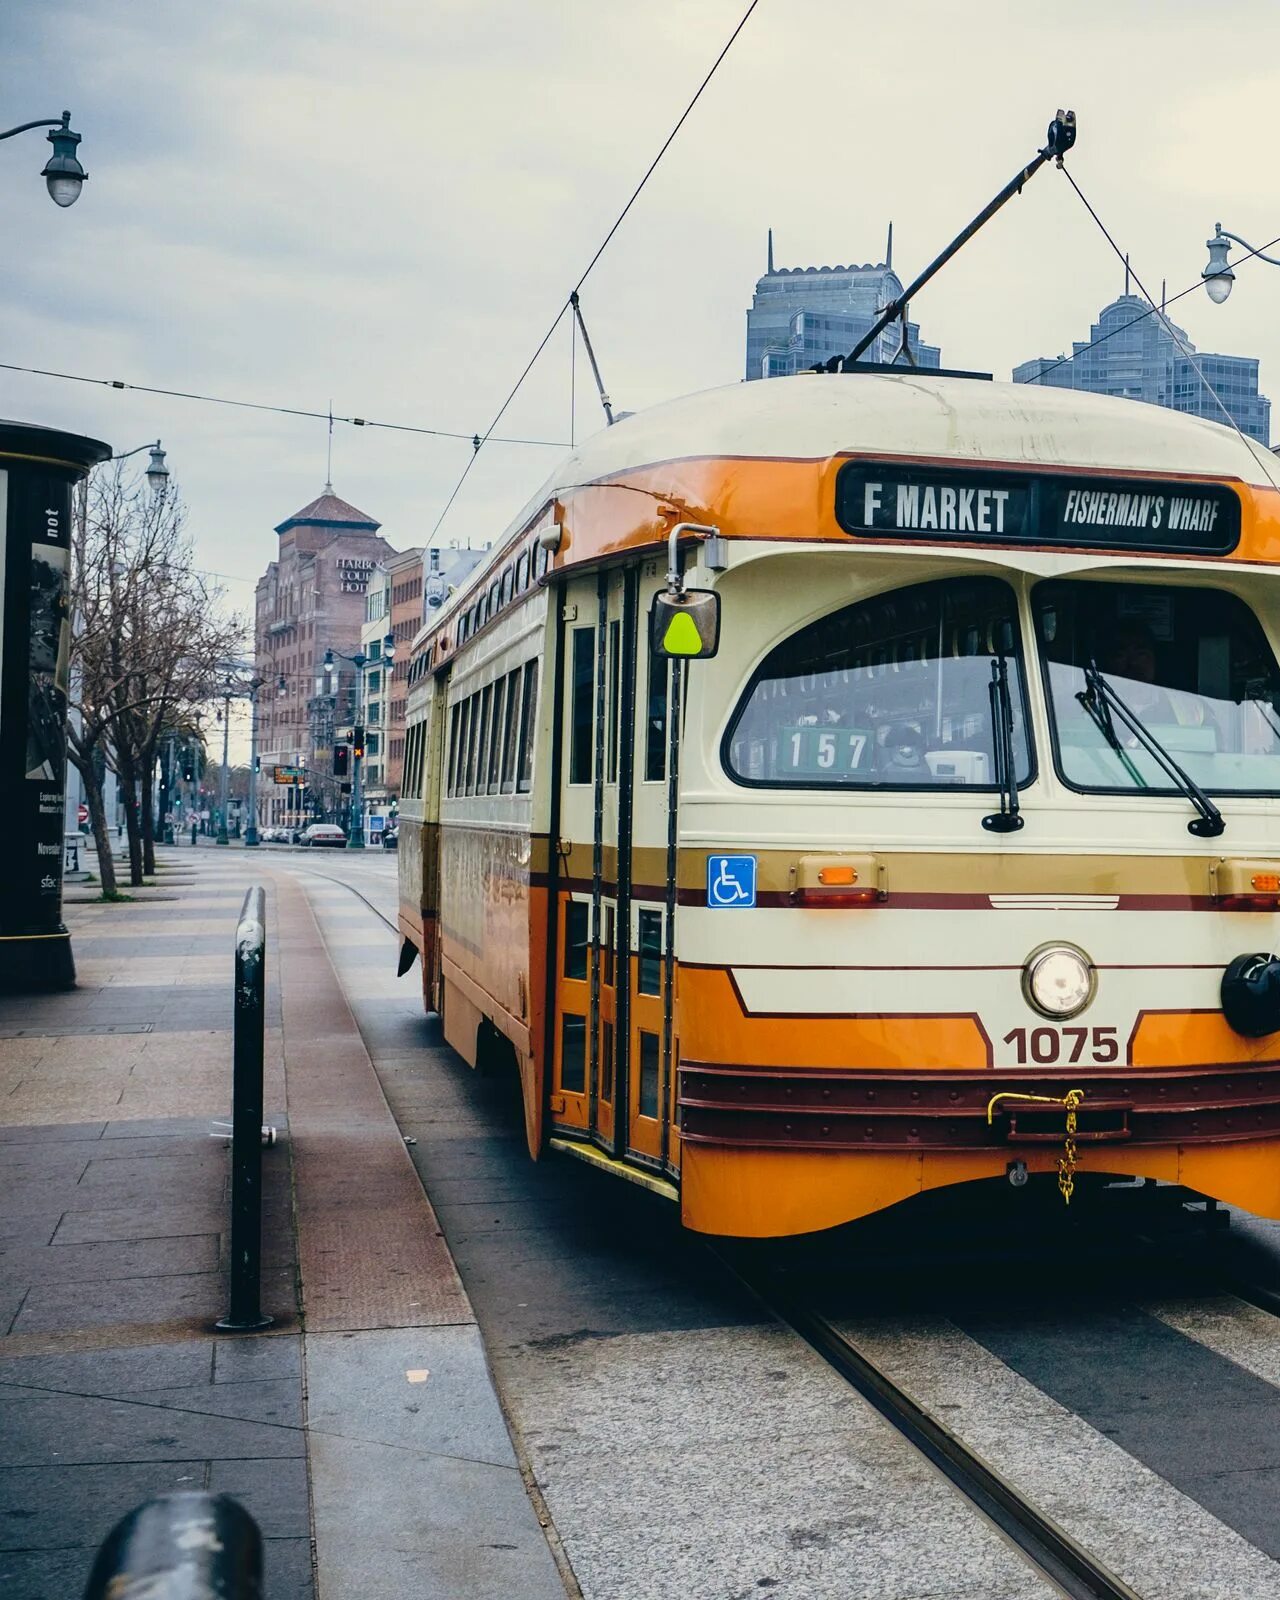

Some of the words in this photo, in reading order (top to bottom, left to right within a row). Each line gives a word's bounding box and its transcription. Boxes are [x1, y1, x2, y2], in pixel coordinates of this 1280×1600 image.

[45, 508, 59, 538] not
[863, 482, 883, 526] F
[896, 484, 1009, 533] MARKET
[1063, 489, 1165, 529] FISHERMAN'S
[1167, 498, 1220, 532] WHARF
[791, 732, 866, 769] 157
[1003, 1027, 1119, 1064] 1075
